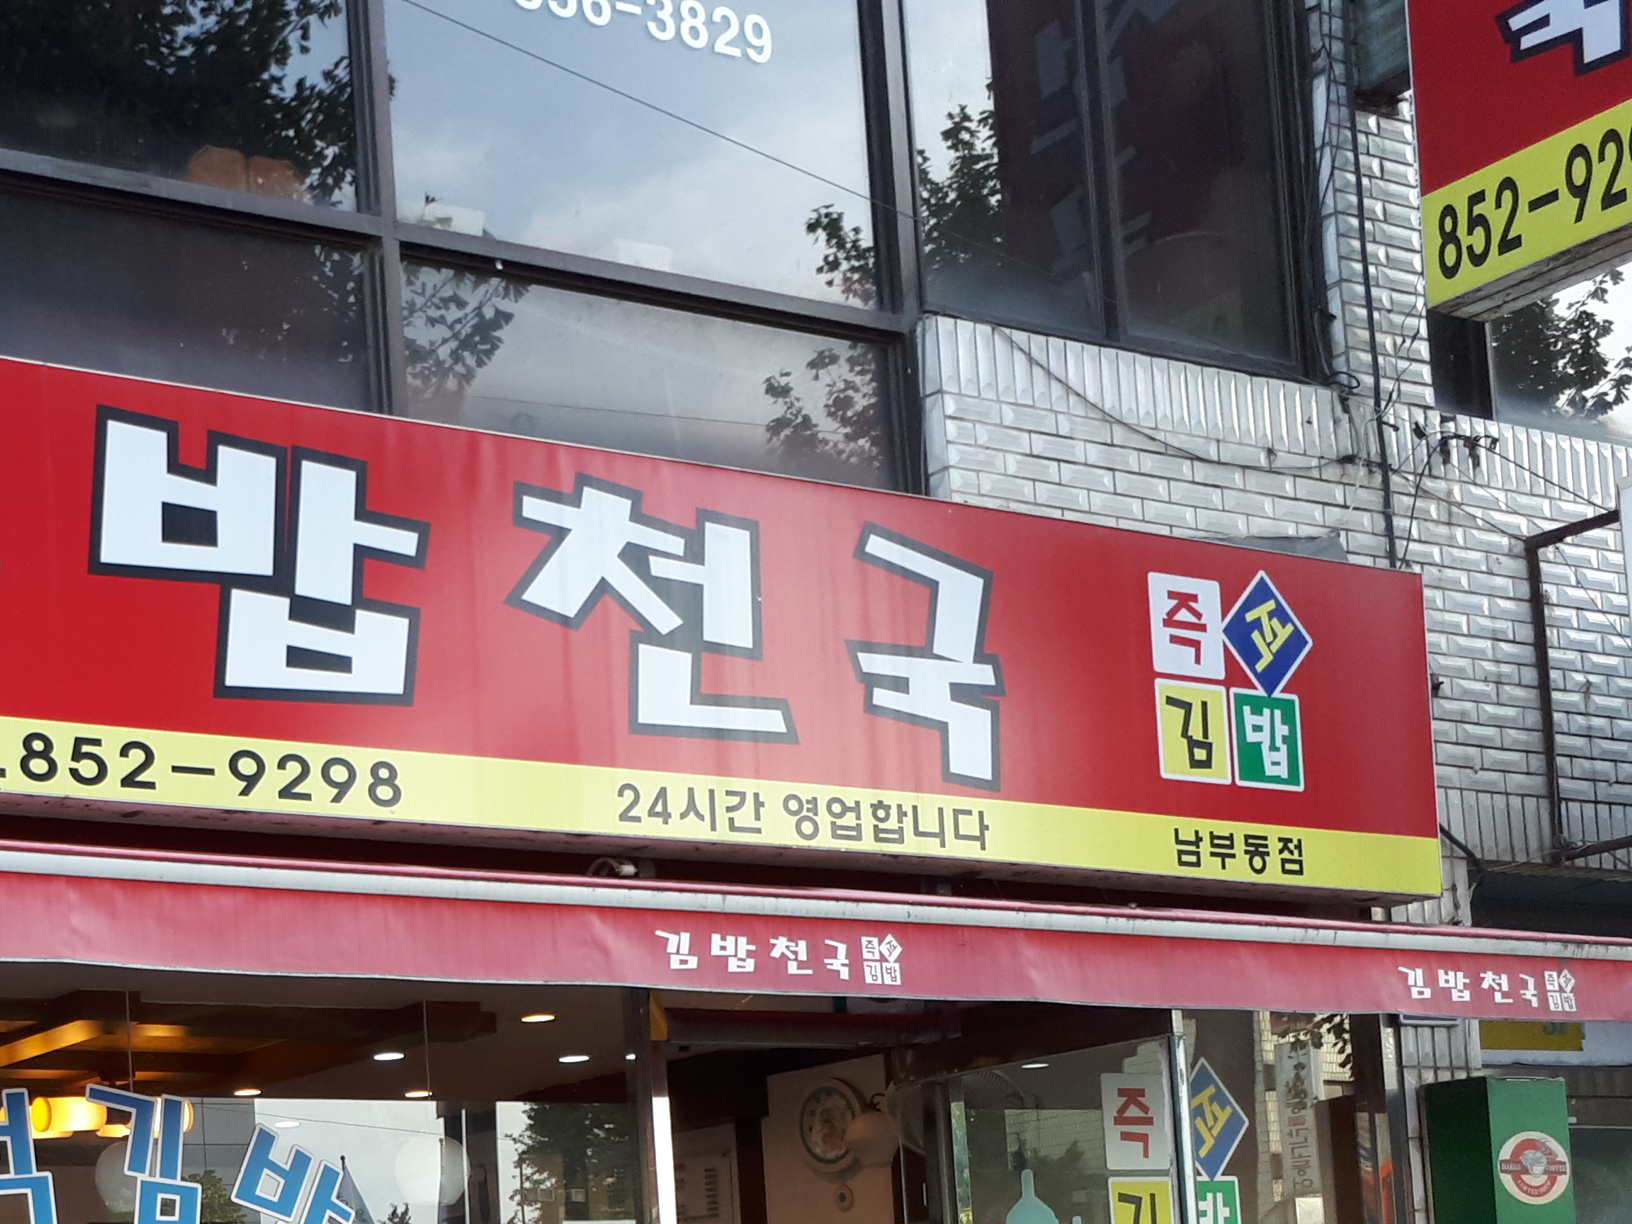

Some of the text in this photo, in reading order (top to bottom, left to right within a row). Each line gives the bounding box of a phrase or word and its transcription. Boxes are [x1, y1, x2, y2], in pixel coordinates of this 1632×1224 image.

[1437, 127, 1632, 280] 852-92
[616, 781, 991, 853] 24시간 영업합니다
[1173, 828, 1304, 876] 남부동점
